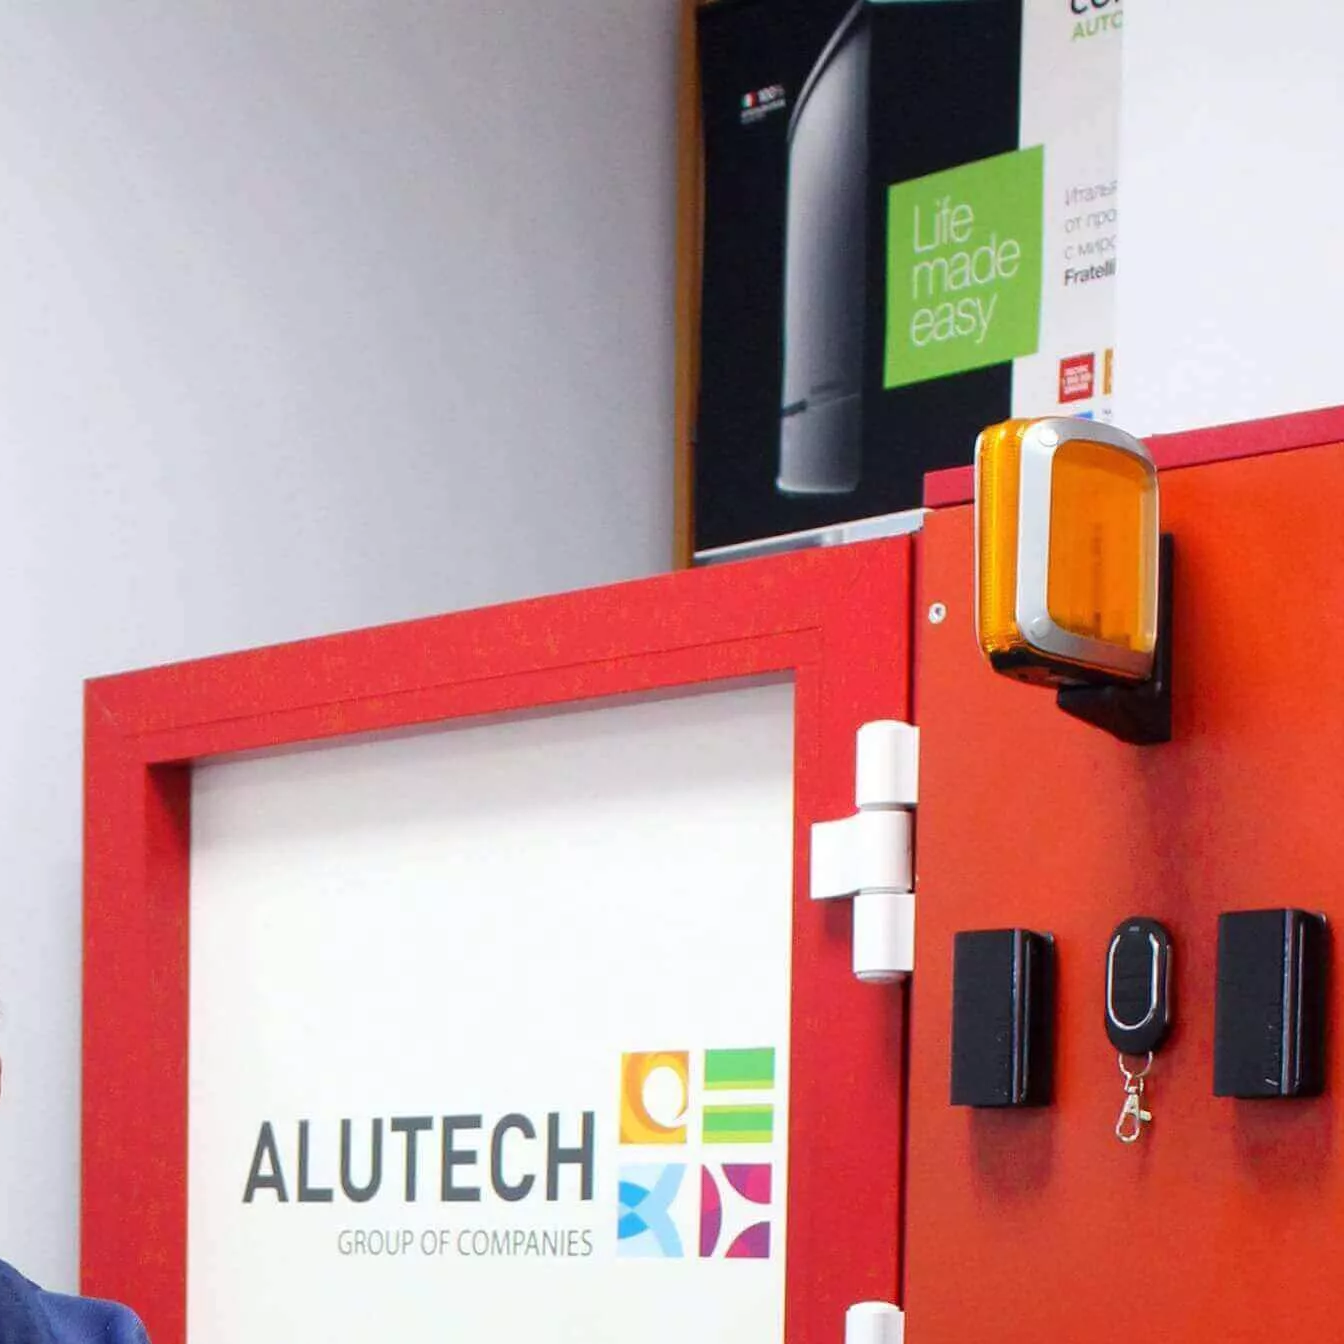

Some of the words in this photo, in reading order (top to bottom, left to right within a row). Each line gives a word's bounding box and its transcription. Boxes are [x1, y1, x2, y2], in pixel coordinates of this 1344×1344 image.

[913, 195, 974, 254] Life
[912, 230, 1021, 300] made
[910, 293, 998, 347] easy
[242, 1111, 594, 1203] ALUTECH
[337, 1229, 414, 1256] GROUP
[420, 1229, 451, 1256] OF
[457, 1229, 593, 1256] COMPANIES
